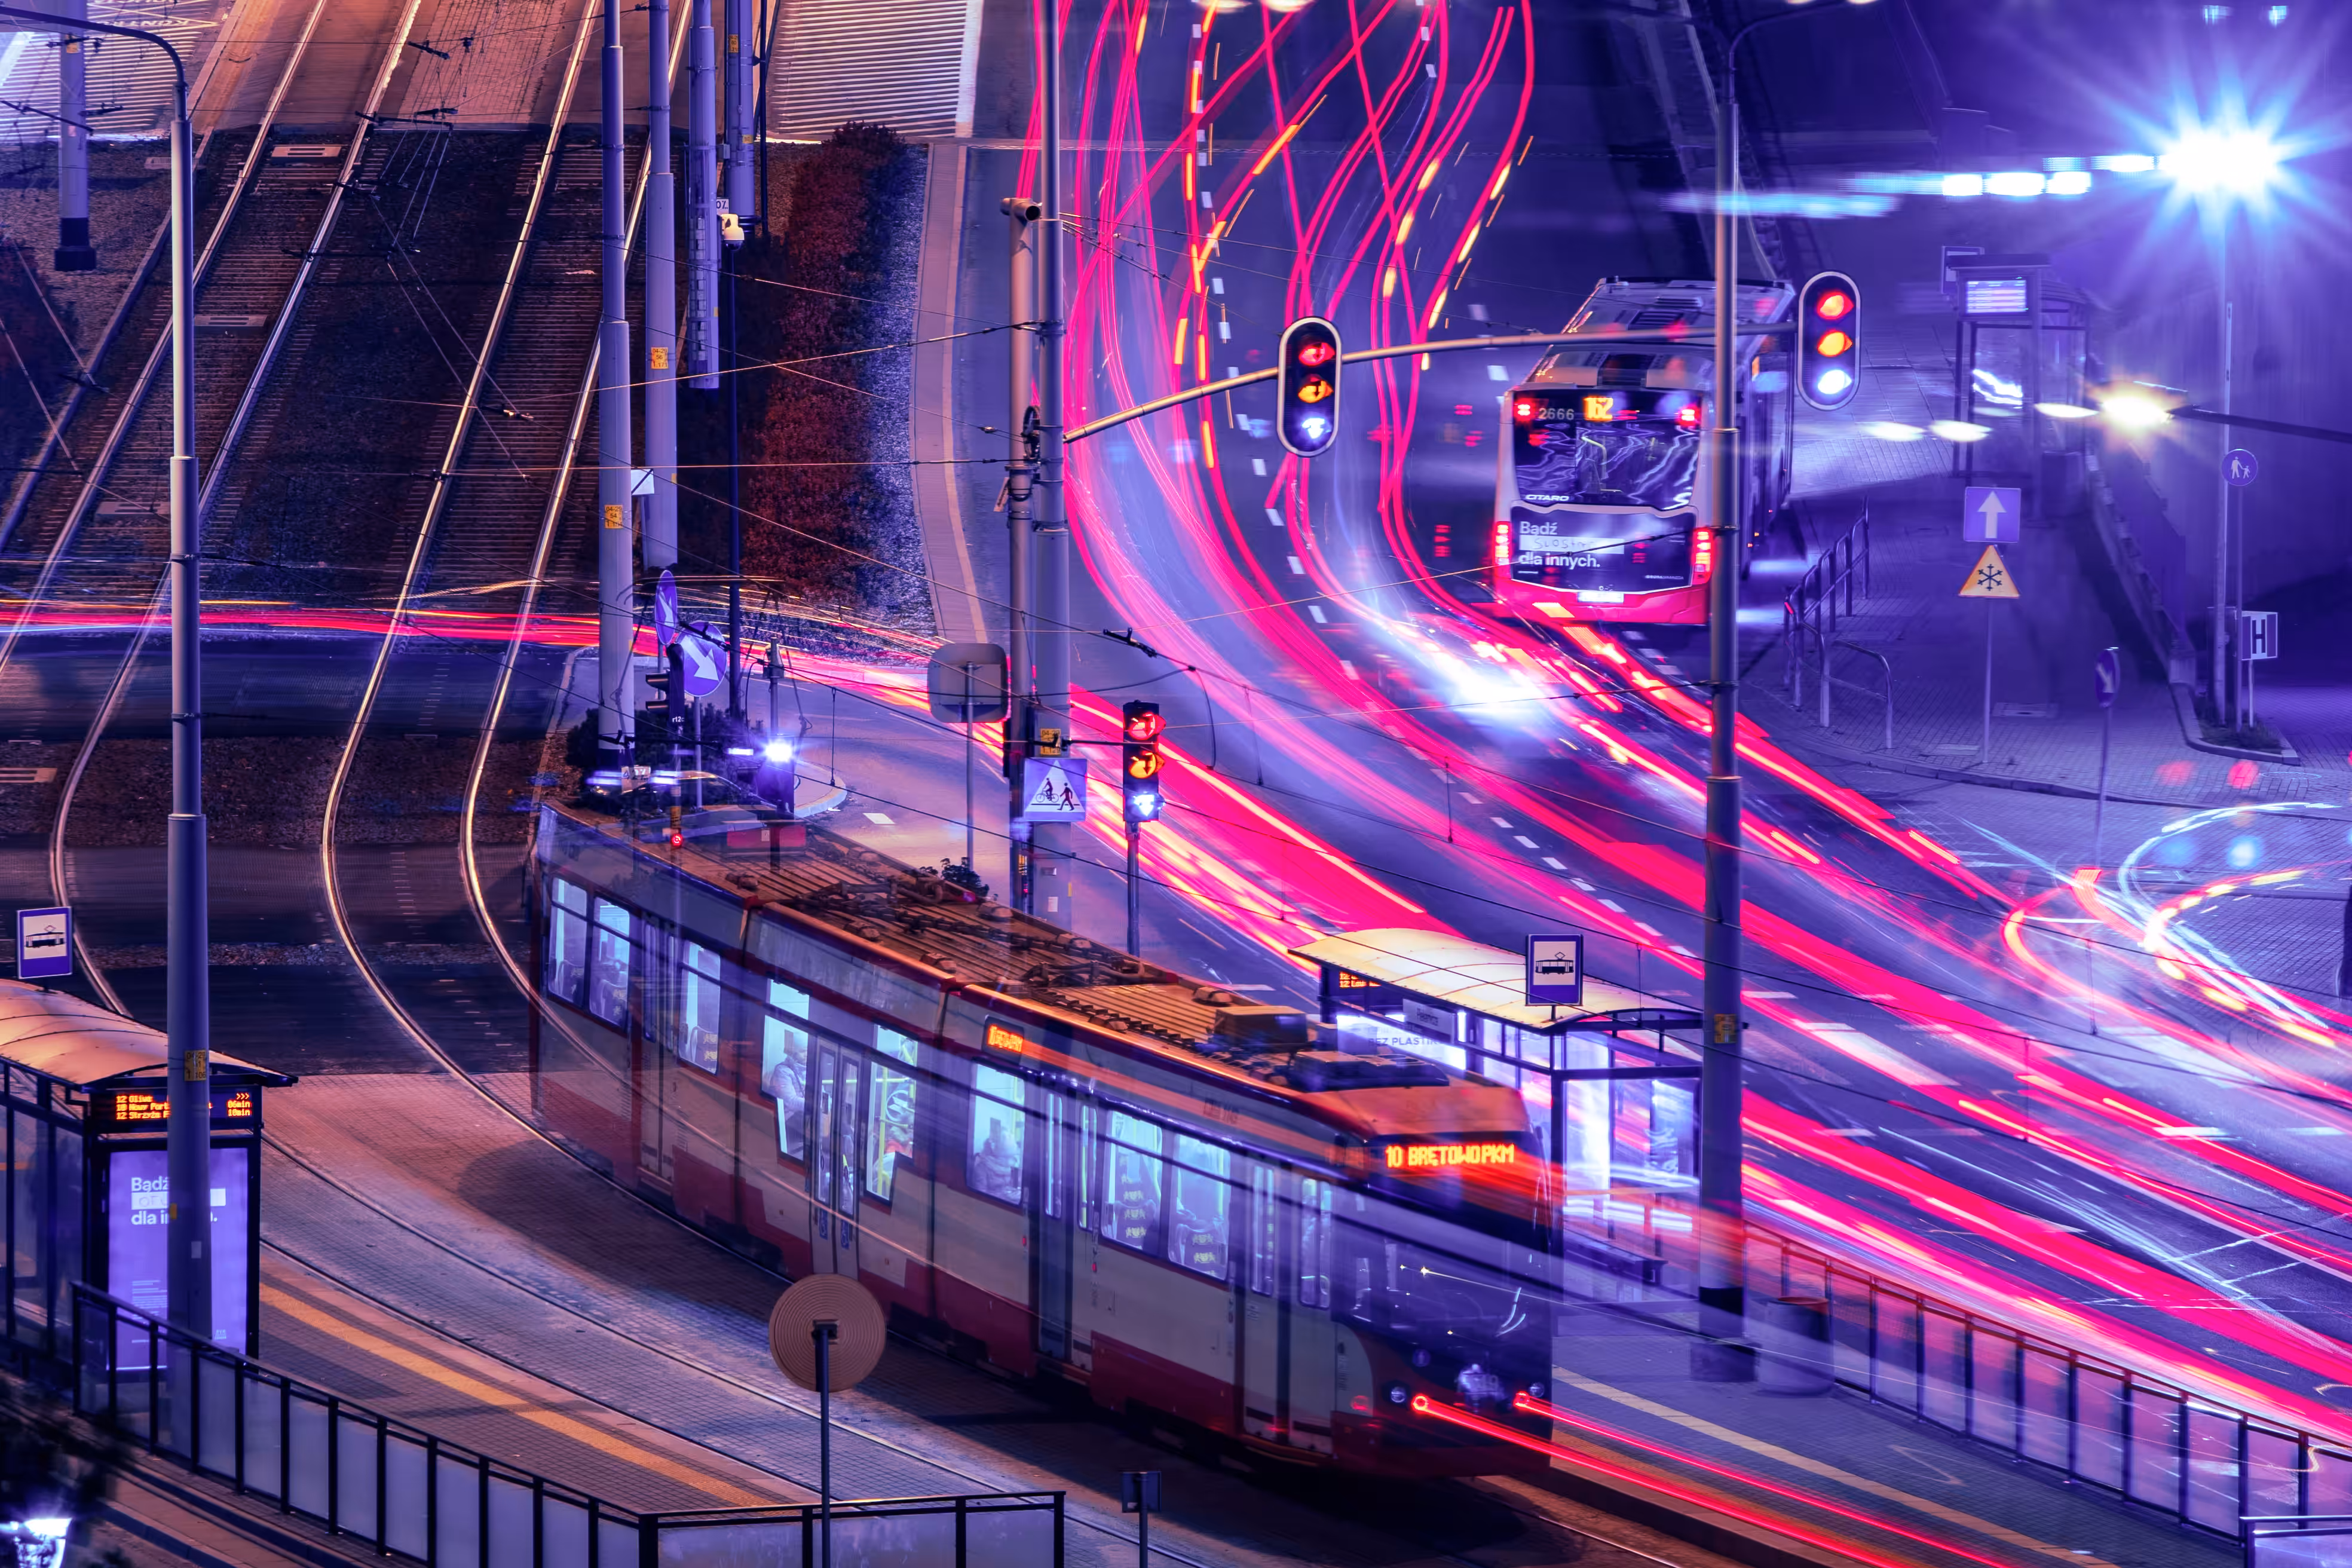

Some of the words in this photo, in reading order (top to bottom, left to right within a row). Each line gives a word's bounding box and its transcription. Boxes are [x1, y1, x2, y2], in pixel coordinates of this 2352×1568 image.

[1539, 408, 1575, 420] 2666
[1520, 520, 1558, 536] Bądź
[1518, 552, 1543, 565] dla
[1545, 553, 1601, 570] innych.
[2252, 618, 2266, 654] H
[117, 1111, 127, 1120] 12
[1385, 1145, 1403, 1168] 10
[131, 1210, 157, 1225] dla
